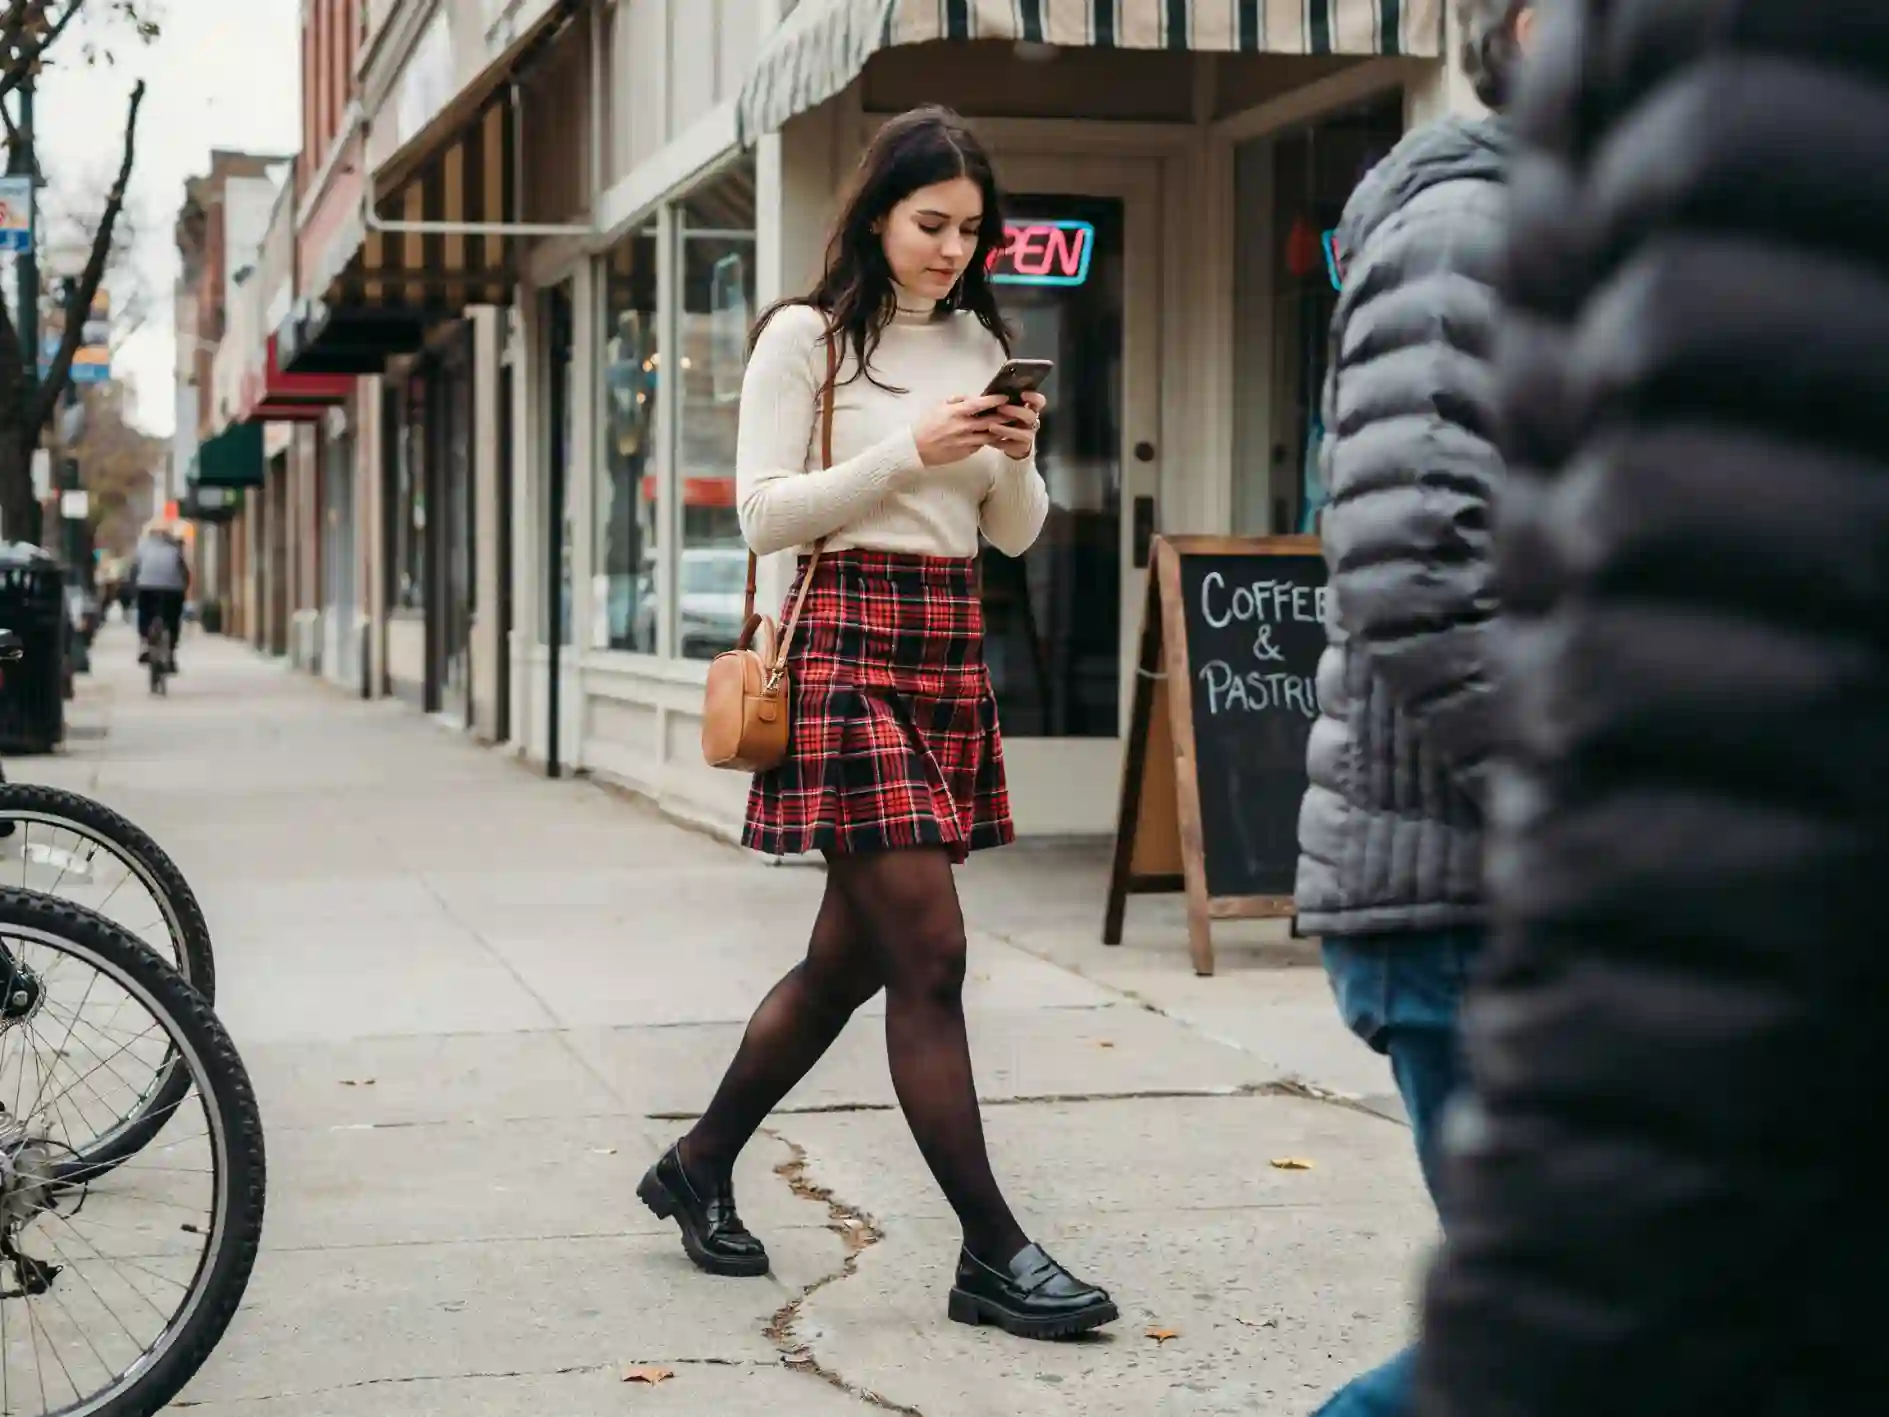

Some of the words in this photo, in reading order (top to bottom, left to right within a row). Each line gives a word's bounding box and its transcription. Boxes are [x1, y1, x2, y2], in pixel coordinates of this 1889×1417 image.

[985, 225, 1085, 276] PEN
[1253, 624, 1285, 661] &
[1200, 660, 1316, 718] PASTRI
